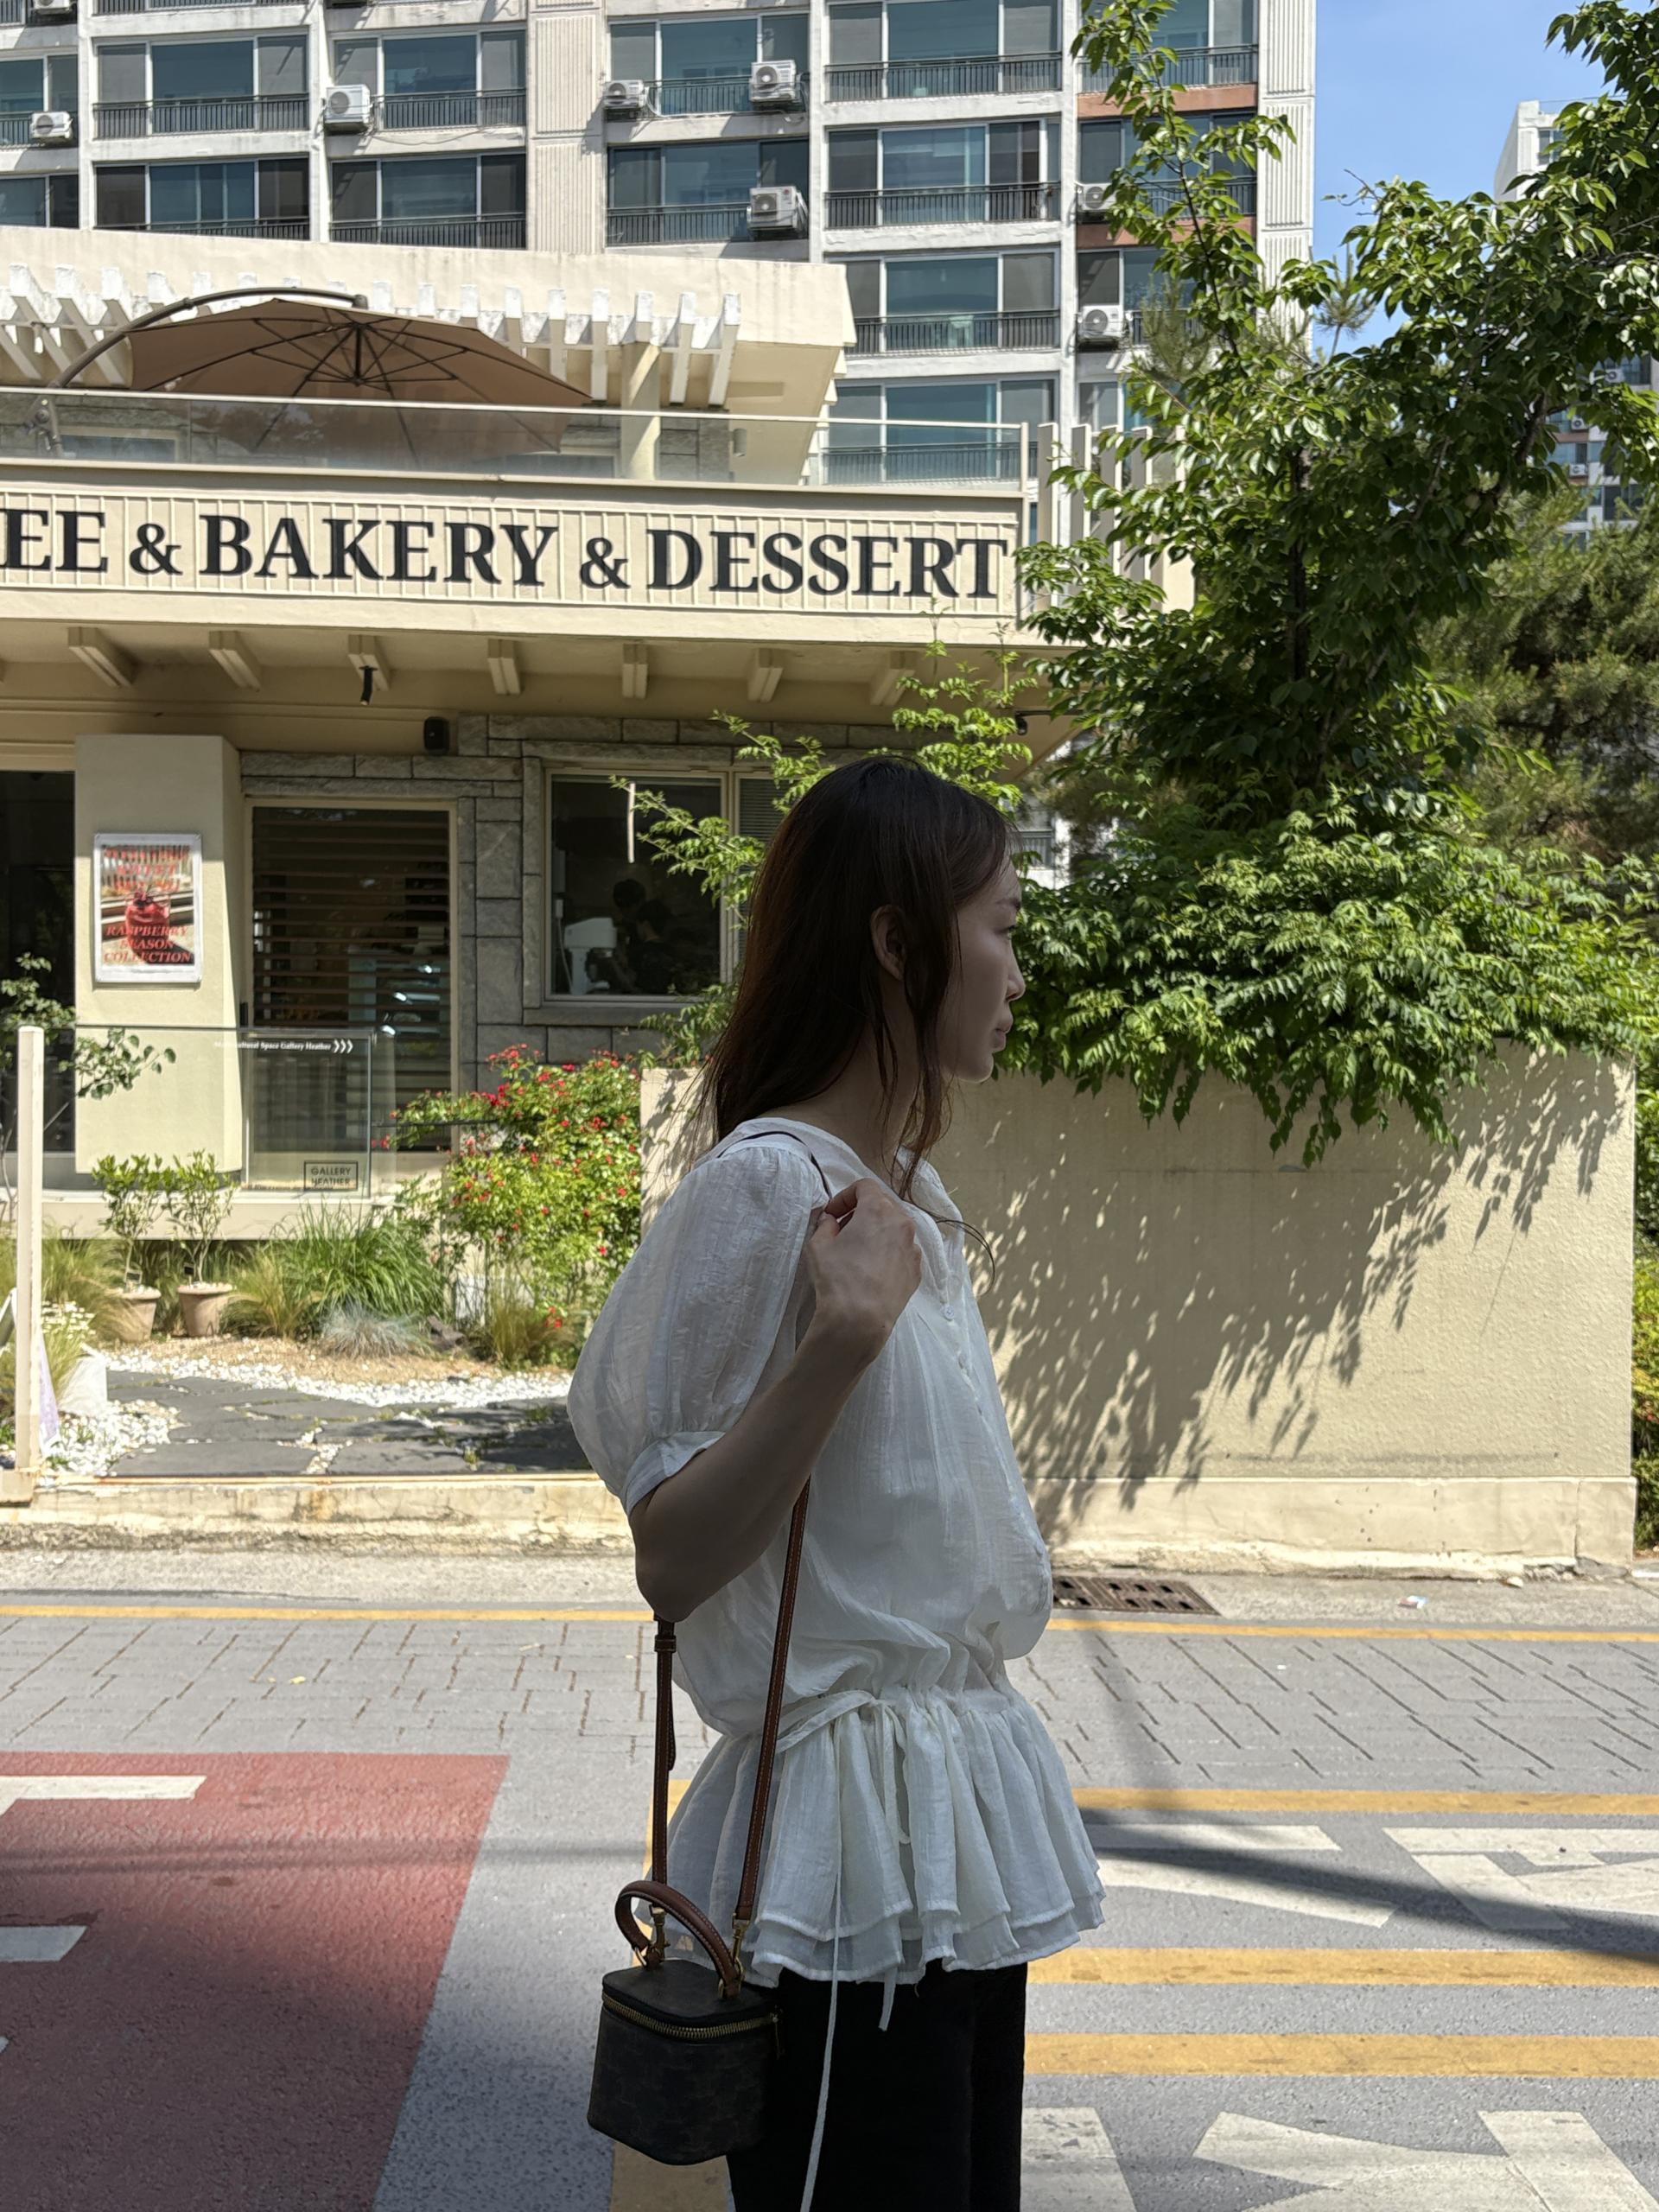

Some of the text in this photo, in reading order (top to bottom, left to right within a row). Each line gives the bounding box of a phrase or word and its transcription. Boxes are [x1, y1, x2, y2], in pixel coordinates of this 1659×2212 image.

[129, 523, 183, 576] &
[199, 514, 559, 586] BAKERY
[580, 537, 629, 589] &
[646, 528, 1008, 598] DESSERT
[103, 951, 192, 963] COLLECTION
[311, 1167, 352, 1176] GALLERY
